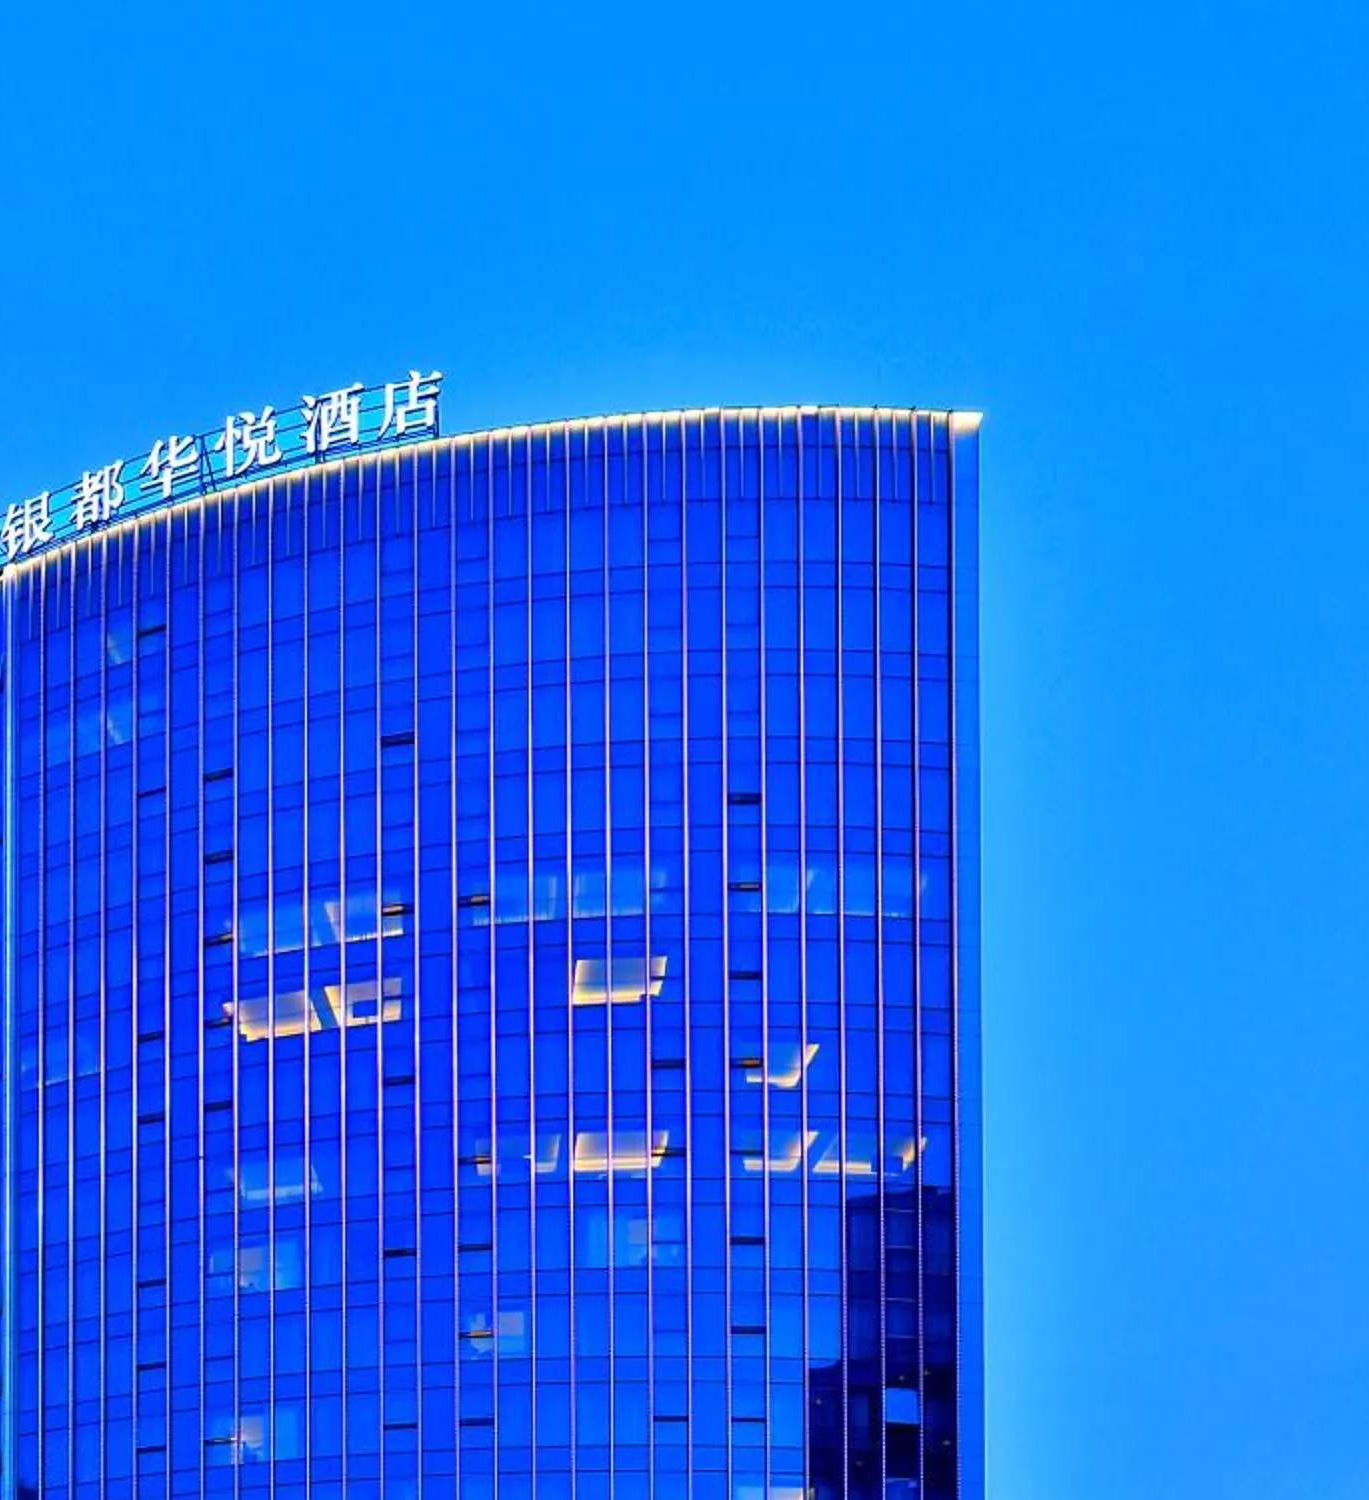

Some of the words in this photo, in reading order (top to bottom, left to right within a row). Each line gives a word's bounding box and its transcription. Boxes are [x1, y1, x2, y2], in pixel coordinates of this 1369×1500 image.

[0, 370, 442, 559] 银都华悦酒店
